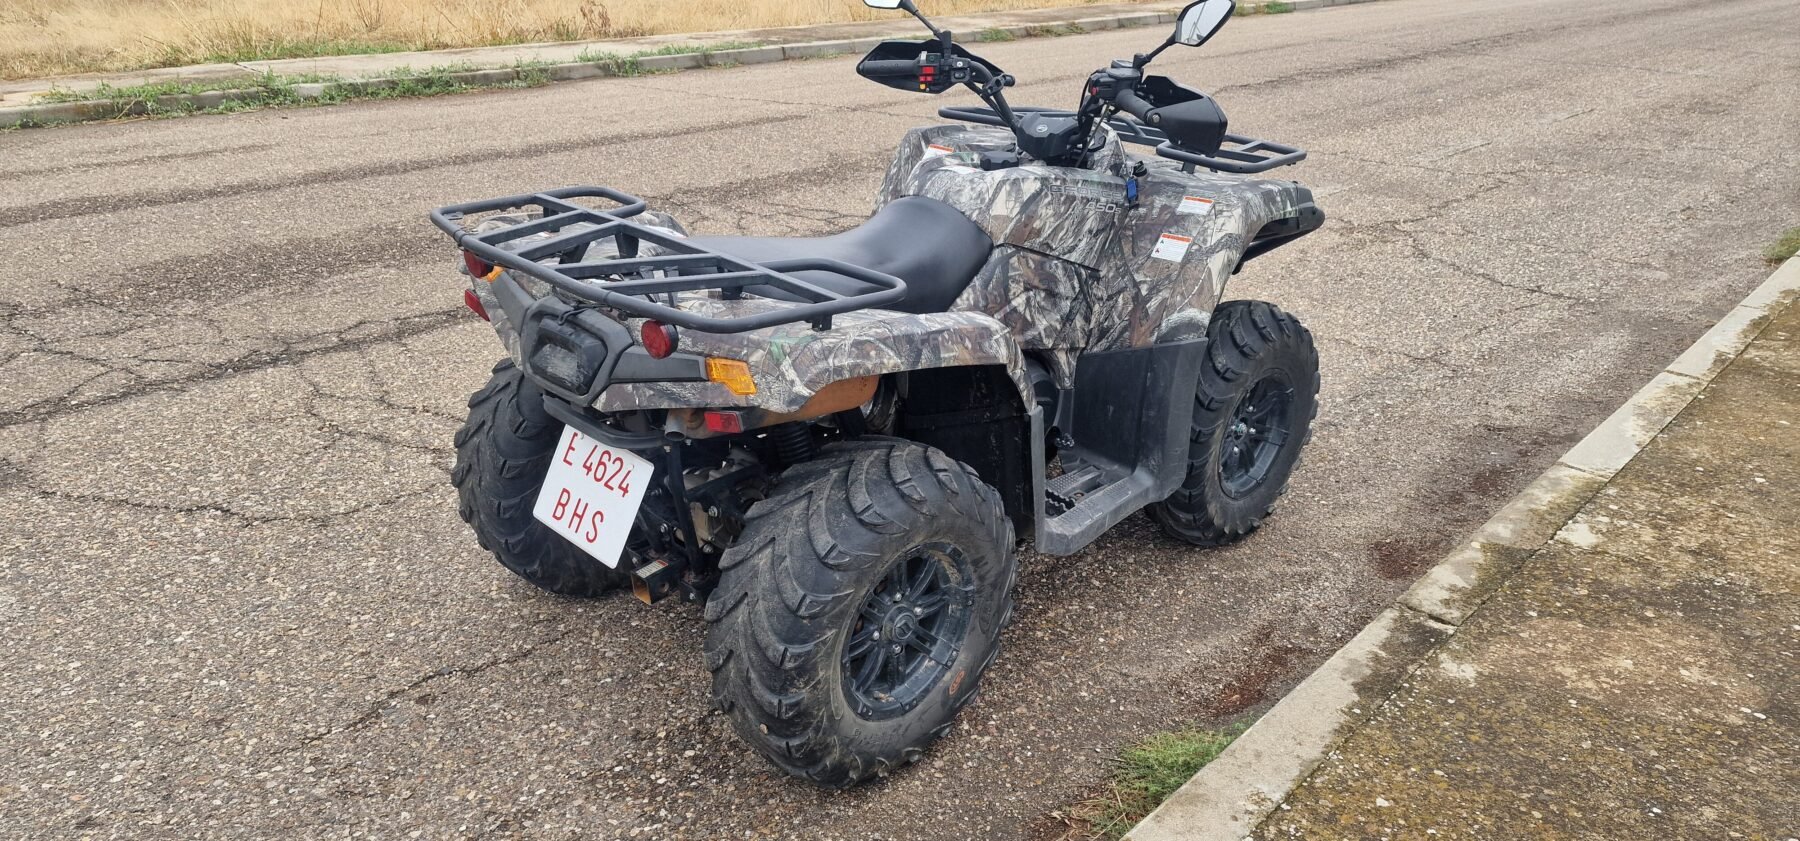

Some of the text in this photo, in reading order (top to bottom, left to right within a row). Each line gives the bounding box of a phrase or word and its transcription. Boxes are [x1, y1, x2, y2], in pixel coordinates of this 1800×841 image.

[563, 432, 632, 498] E 4624
[552, 487, 604, 543] BHS
